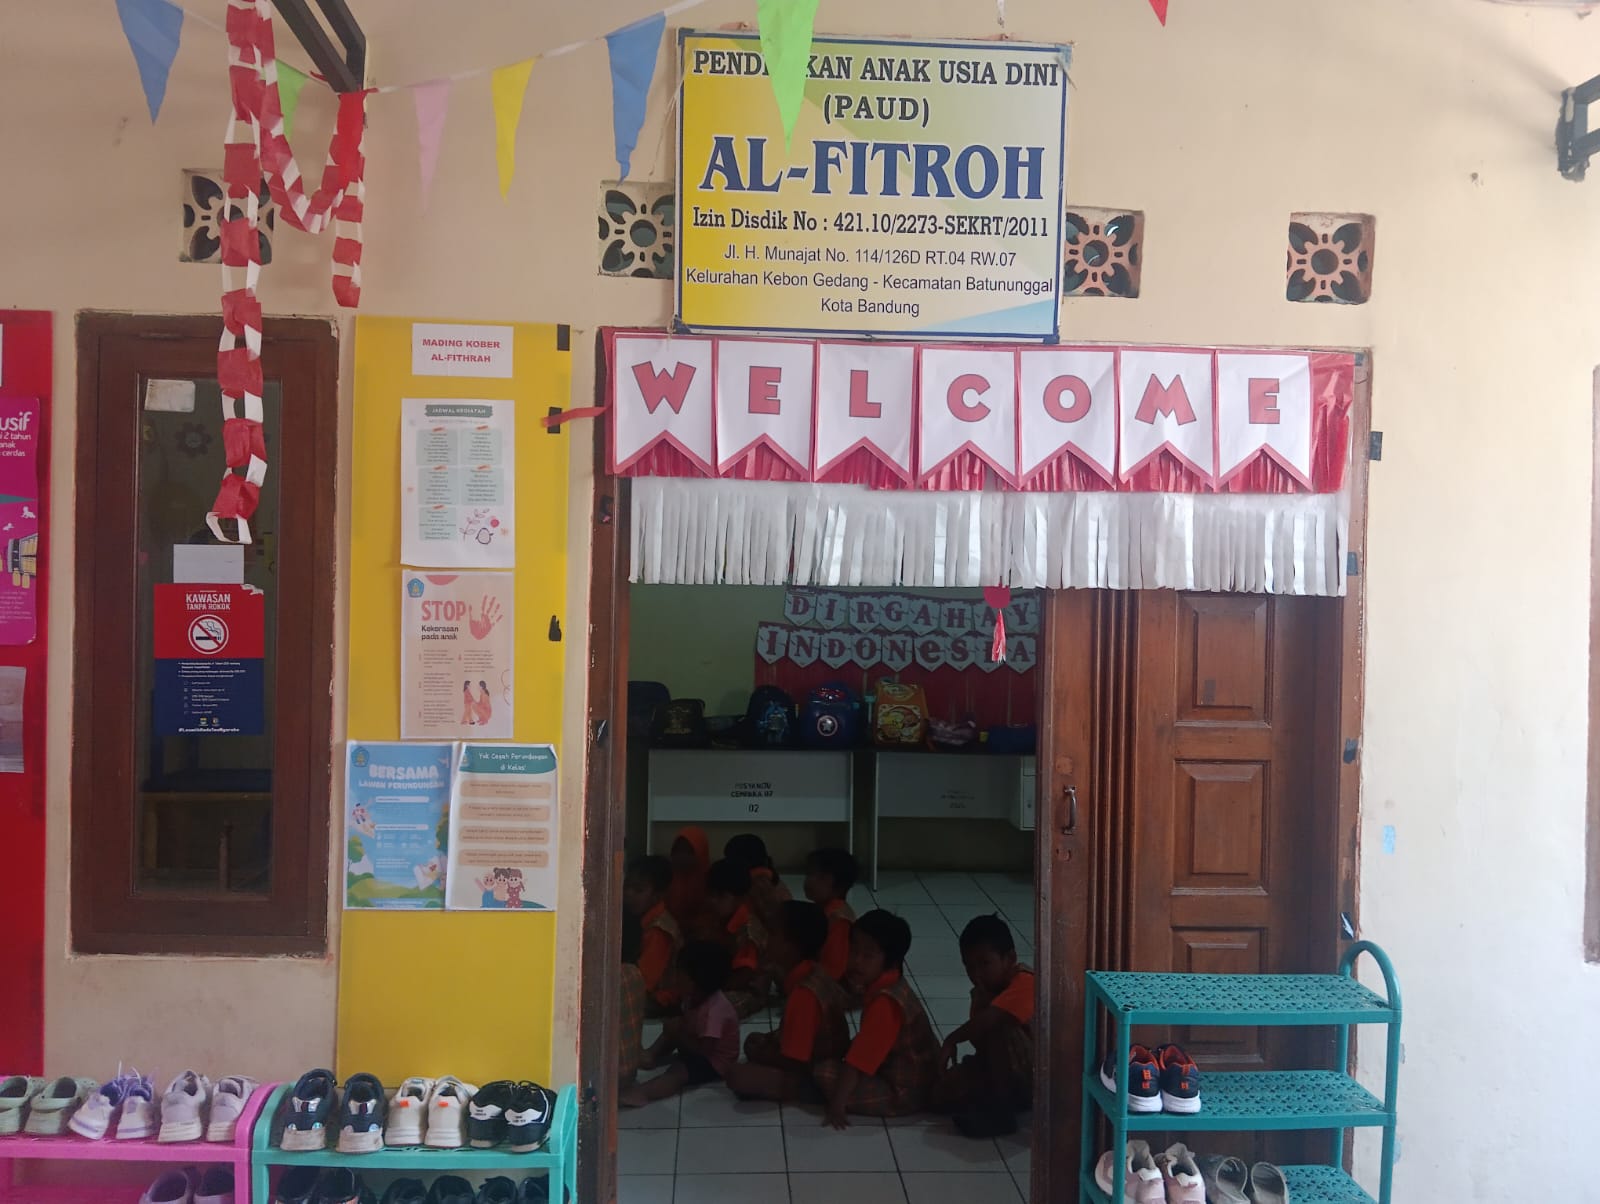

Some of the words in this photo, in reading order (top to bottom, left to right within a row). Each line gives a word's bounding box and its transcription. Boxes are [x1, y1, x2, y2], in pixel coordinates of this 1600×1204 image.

[861, 58, 930, 82] ANAK
[939, 62, 997, 84] USIA
[1006, 63, 1058, 87] DINI
[823, 94, 930, 127] (PAUD)
[698, 136, 1045, 200] AL-FITROH
[693, 207, 725, 228] Izin
[731, 208, 787, 230] Disdik
[794, 210, 816, 231] No
[834, 212, 1048, 237] 421.10/2273-SEKRT/2011
[724, 244, 740, 260] Jl.
[745, 245, 760, 261] H.
[765, 246, 821, 264] Munajat
[826, 248, 849, 262] No.
[856, 248, 920, 265] 114/126D
[925, 251, 965, 265] RT.04
[970, 252, 1017, 267] RW.07
[686, 268, 758, 285] Kelurahan
[763, 270, 808, 287] Kebon
[813, 272, 868, 291] Gedang
[883, 274, 961, 291] Kecamatan
[966, 277, 1053, 295] Batununggal
[821, 298, 853, 314] Kota
[858, 299, 920, 318] Bandung
[422, 338, 463, 348] MADING
[466, 340, 501, 349] KOBER
[431, 353, 491, 362] AL-FITHRAH
[631, 360, 1280, 426] WELCOME
[10, 431, 32, 441] tahun
[2, 449, 26, 457] cerdas
[186, 593, 231, 603] KAWASAN
[421, 601, 467, 621] STOP
[369, 764, 439, 780] BERSAMA
